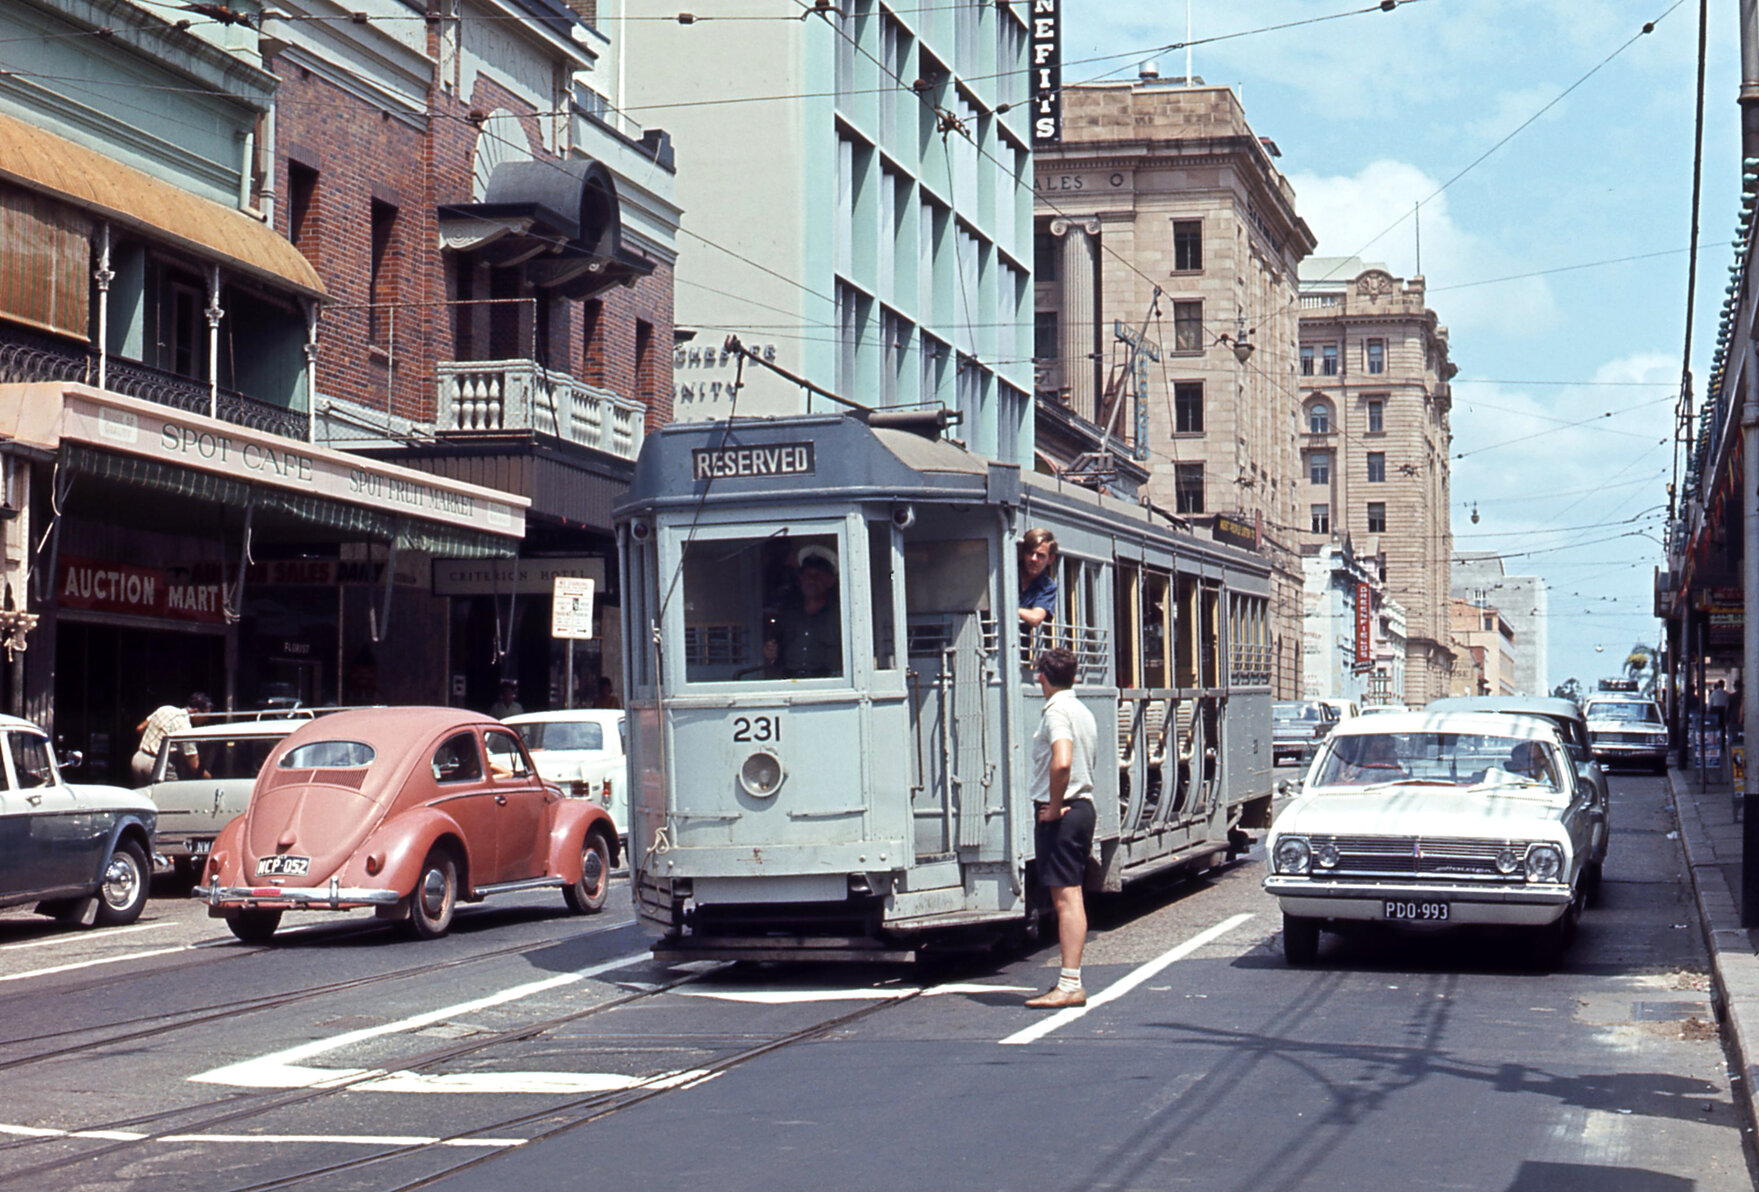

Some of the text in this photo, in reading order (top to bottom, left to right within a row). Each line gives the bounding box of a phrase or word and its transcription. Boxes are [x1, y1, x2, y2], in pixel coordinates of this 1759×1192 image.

[1034, 176, 1083, 190] ALES
[674, 345, 777, 366] CHESER
[674, 381, 737, 403] NITY
[161, 423, 232, 462] SPOT
[242, 444, 313, 482] CAFE
[697, 447, 808, 477] RESERVED
[349, 469, 383, 497] SPOT
[388, 478, 424, 506] FRUIT
[429, 487, 475, 517] MARKET
[192, 563, 268, 583] AUTON
[275, 562, 328, 583] SALES
[449, 568, 586, 582] CRITERION HOTEL
[64, 566, 219, 612] AUCTION MART
[733, 716, 781, 742] 231
